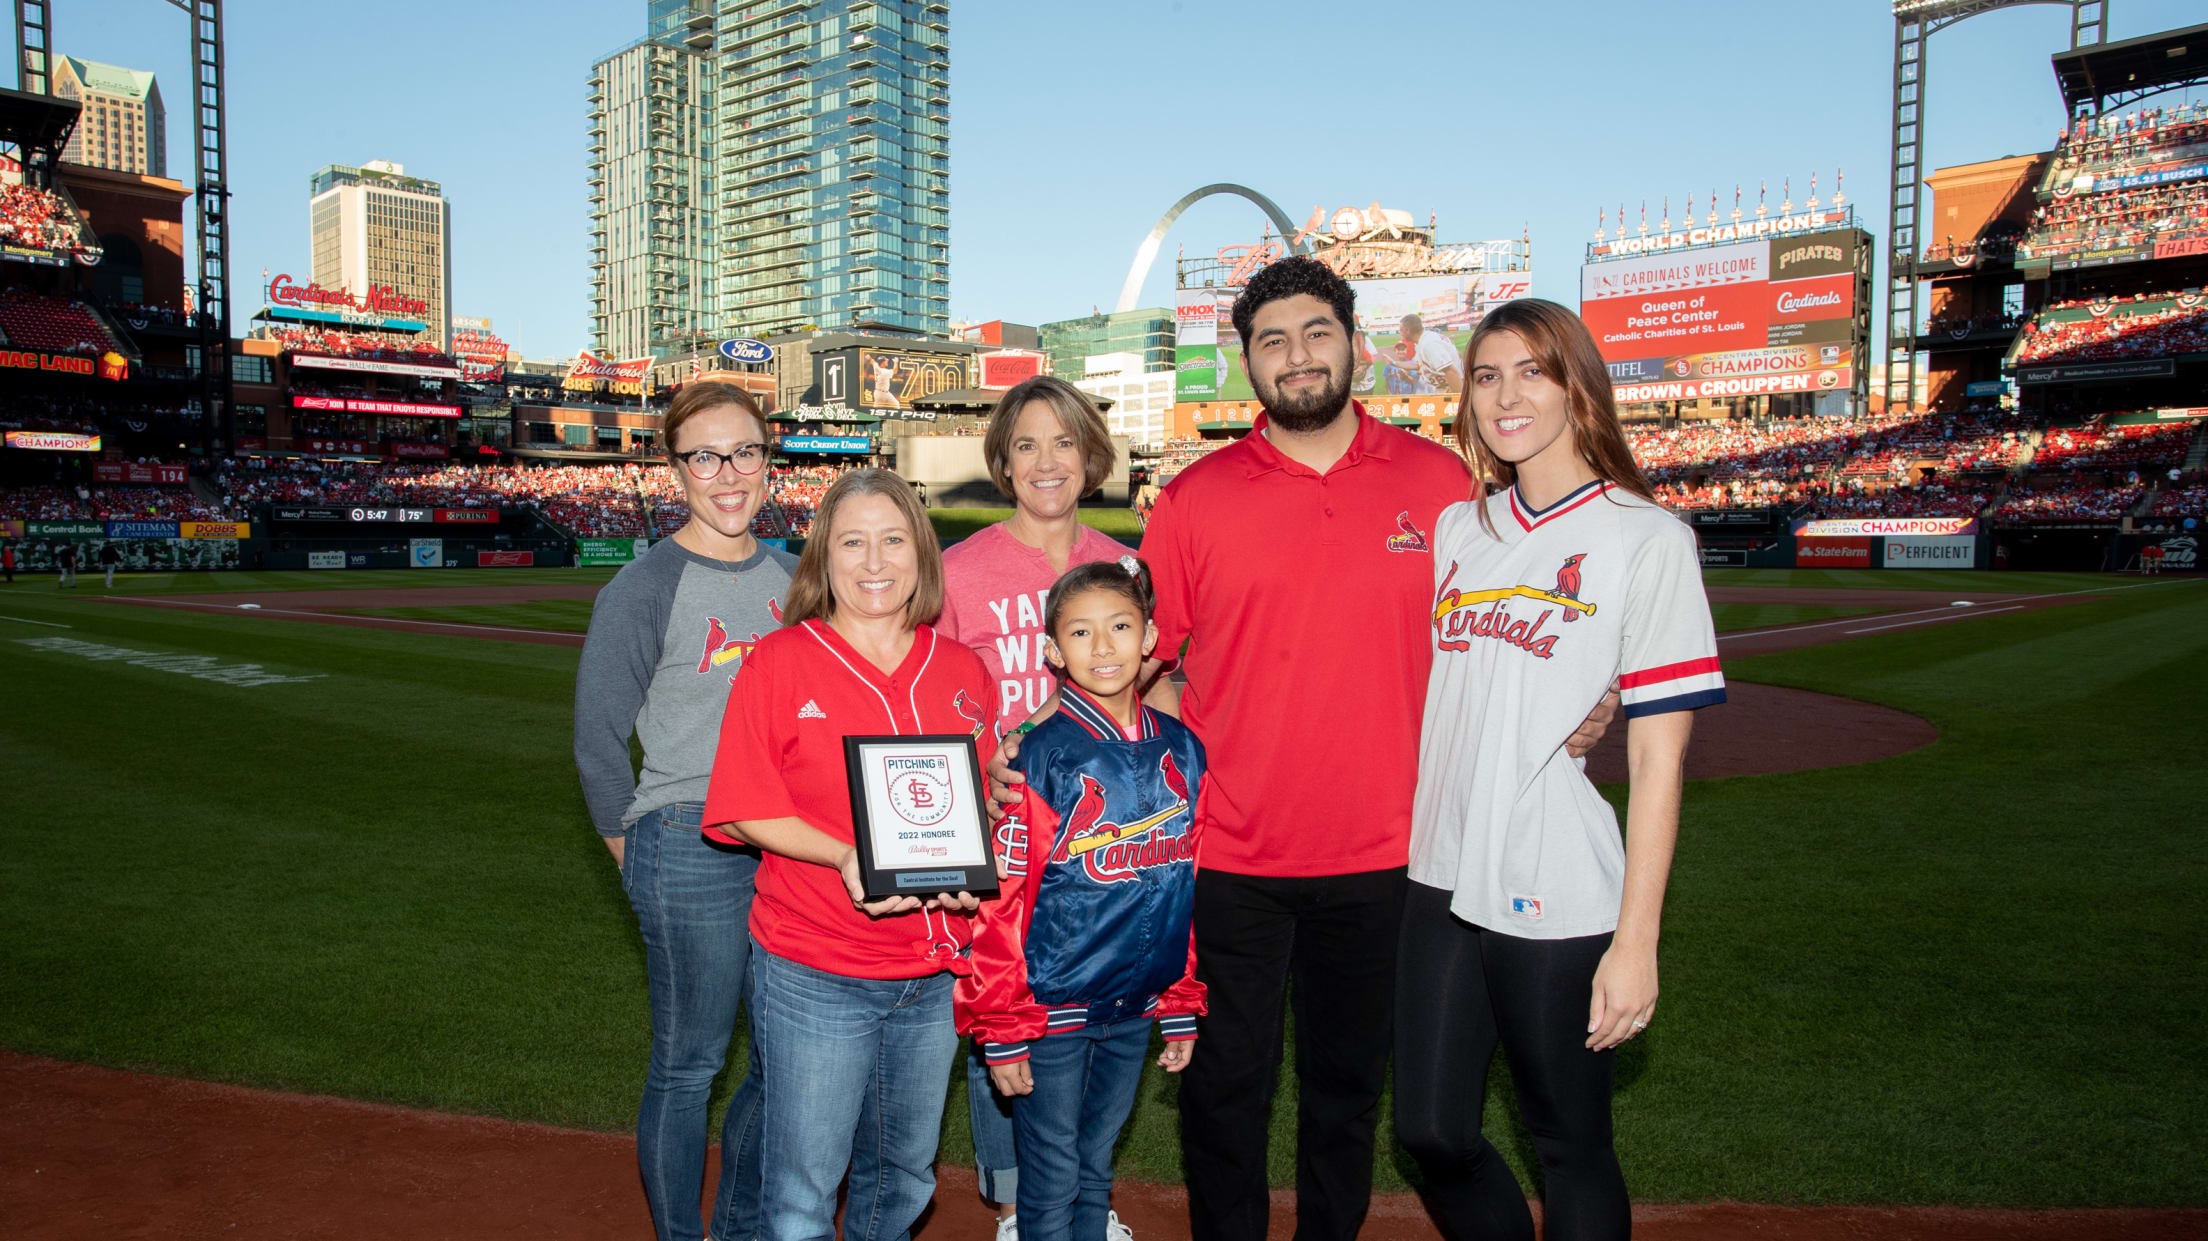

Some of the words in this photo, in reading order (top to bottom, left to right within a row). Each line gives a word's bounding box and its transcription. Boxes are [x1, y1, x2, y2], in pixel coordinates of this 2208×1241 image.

[2162, 166, 2202, 181] BUSCH
[1608, 234, 1685, 255] WORLD
[1690, 212, 1826, 244] CHAMPIONS
[1780, 245, 1843, 270] PIRATES
[2082, 248, 2135, 259] Montgomery
[1623, 265, 1690, 286] CARDINALS
[1696, 257, 1757, 277] WELCOME
[270, 274, 357, 307] Cardinals
[355, 284, 429, 315] Nation
[1641, 299, 1685, 314] Queen
[1690, 296, 1705, 308] of
[1777, 290, 1841, 313] Cardinals
[1177, 304, 1216, 316] KMOX
[341, 315, 385, 326] ROOFTOP
[452, 315, 482, 328] ARSON
[1628, 314, 1667, 328] Peace
[1671, 309, 1718, 324] Center
[1603, 331, 1641, 343] Catholic
[1644, 326, 1686, 338] Charities
[1689, 326, 1699, 334] of
[1702, 324, 1715, 333] St.
[1717, 321, 1745, 332] Louis
[452, 330, 511, 361] Bally
[731, 341, 765, 359] Ford
[1717, 352, 1758, 360] CENTRAL
[1763, 347, 1806, 355] DIVISION
[40, 353, 95, 375] LAND
[349, 361, 365, 369] HALL
[372, 363, 389, 371] FAME
[1606, 361, 1645, 377] TIFEL
[1700, 353, 1808, 376] CHAMPIONS
[2026, 372, 2051, 382] Mercy
[564, 377, 606, 393] BREW
[1615, 383, 1682, 401] BROWN
[1686, 386, 1696, 397] &
[329, 400, 344, 408] JOIN
[348, 401, 358, 409] HE
[359, 402, 375, 410] TEAM
[376, 402, 391, 411] THAT
[393, 403, 415, 413] ENJOYS
[416, 405, 458, 416] RESPONSIBLY.
[869, 409, 899, 417] 1ST
[1367, 404, 1384, 417] 23
[1391, 404, 1410, 417] 24
[1417, 403, 1436, 417] 42
[15, 438, 90, 450] CHAMPIONS
[784, 440, 809, 448] SCOTT
[810, 440, 840, 449] CREDIT
[840, 441, 867, 449] UNION
[161, 470, 184, 482] 194
[281, 511, 300, 520] Mercy
[367, 510, 388, 520] 5:47
[455, 512, 488, 520] PURINA
[1701, 515, 1720, 523] Mercy
[42, 524, 76, 534] Central
[78, 524, 104, 534] Bank
[126, 522, 175, 532] SITEMAN
[195, 524, 237, 533] DOBBS
[1861, 521, 1960, 534] CHAMPIONS
[1887, 543, 1970, 560] PERFICIENT
[1001, 676, 1048, 717] PU
[888, 758, 936, 769] PITCHING
[903, 808, 916, 819] THE
[920, 791, 949, 821] COMMUNITY
[898, 831, 919, 840] 2022
[921, 830, 956, 839] HONOREE
[1082, 821, 1193, 884] Cardinal
